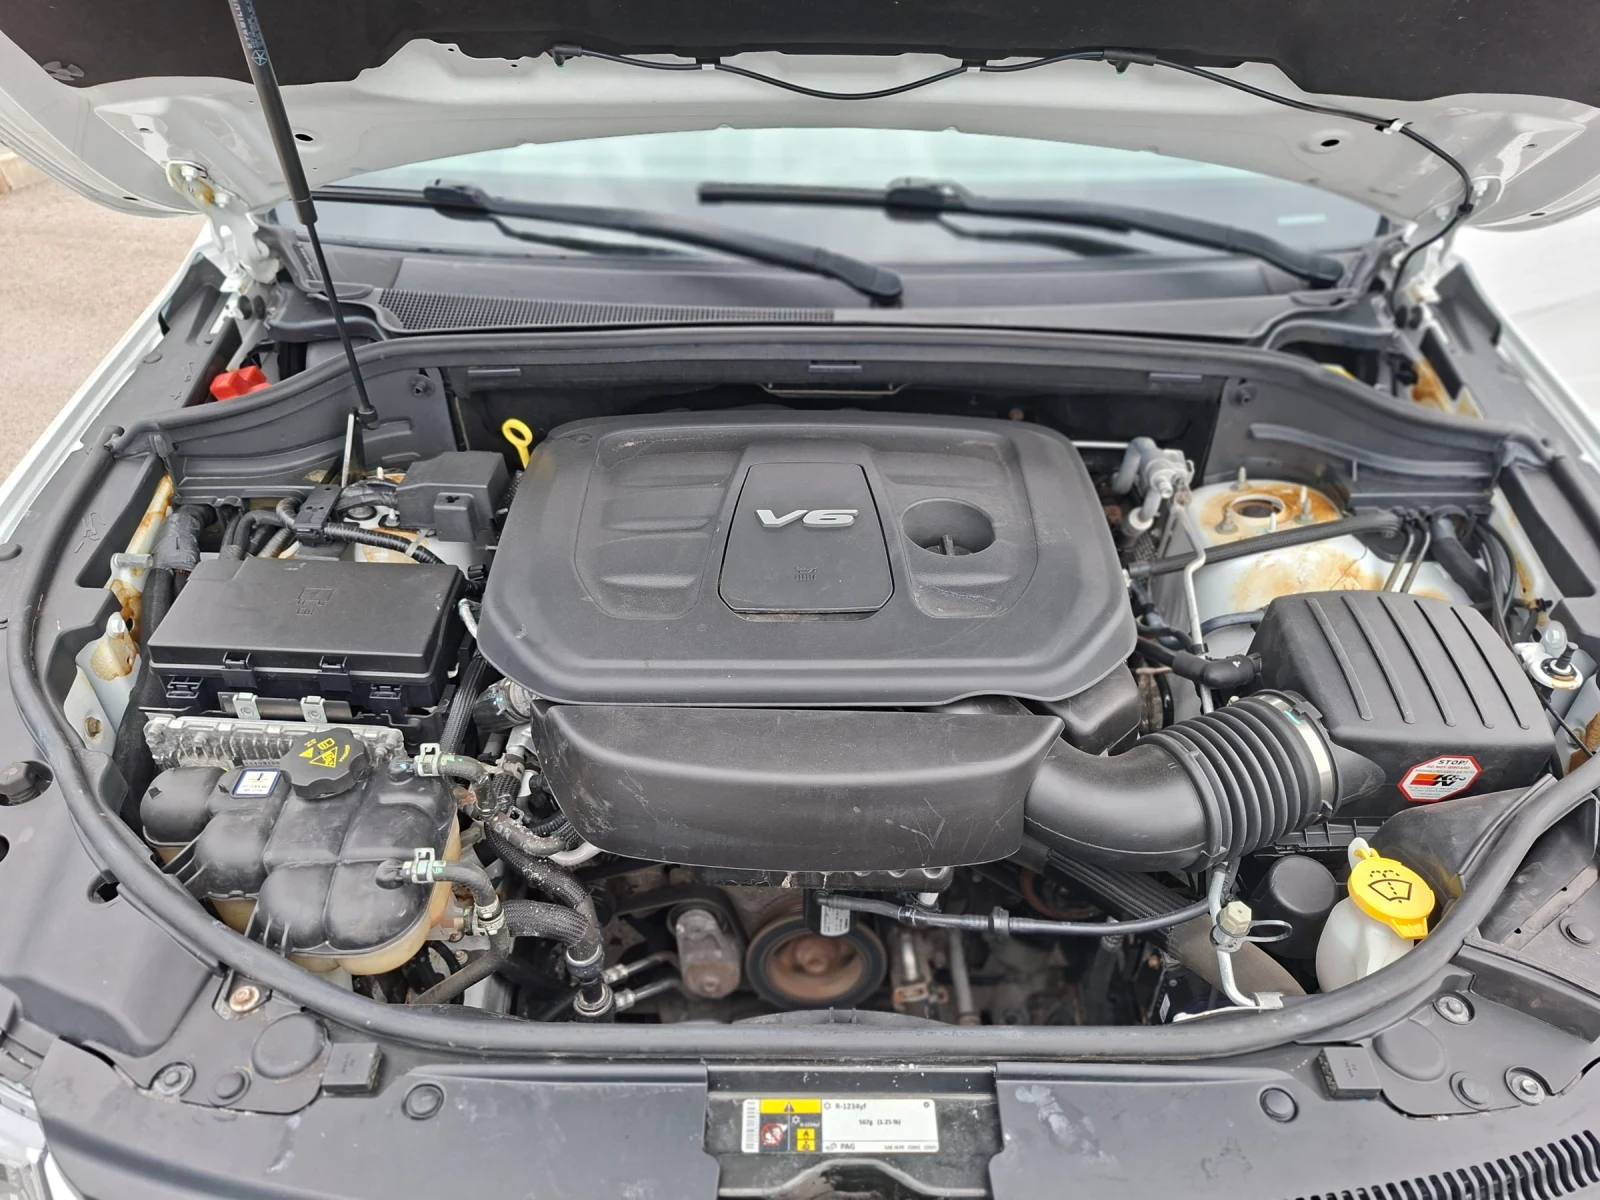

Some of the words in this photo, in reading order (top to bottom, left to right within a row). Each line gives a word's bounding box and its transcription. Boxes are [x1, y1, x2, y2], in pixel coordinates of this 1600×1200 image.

[755, 509, 859, 527] V6
[835, 1102, 867, 1111] R-1234yf
[877, 1118, 892, 1126] (1.25
[893, 1118, 902, 1126] lb)
